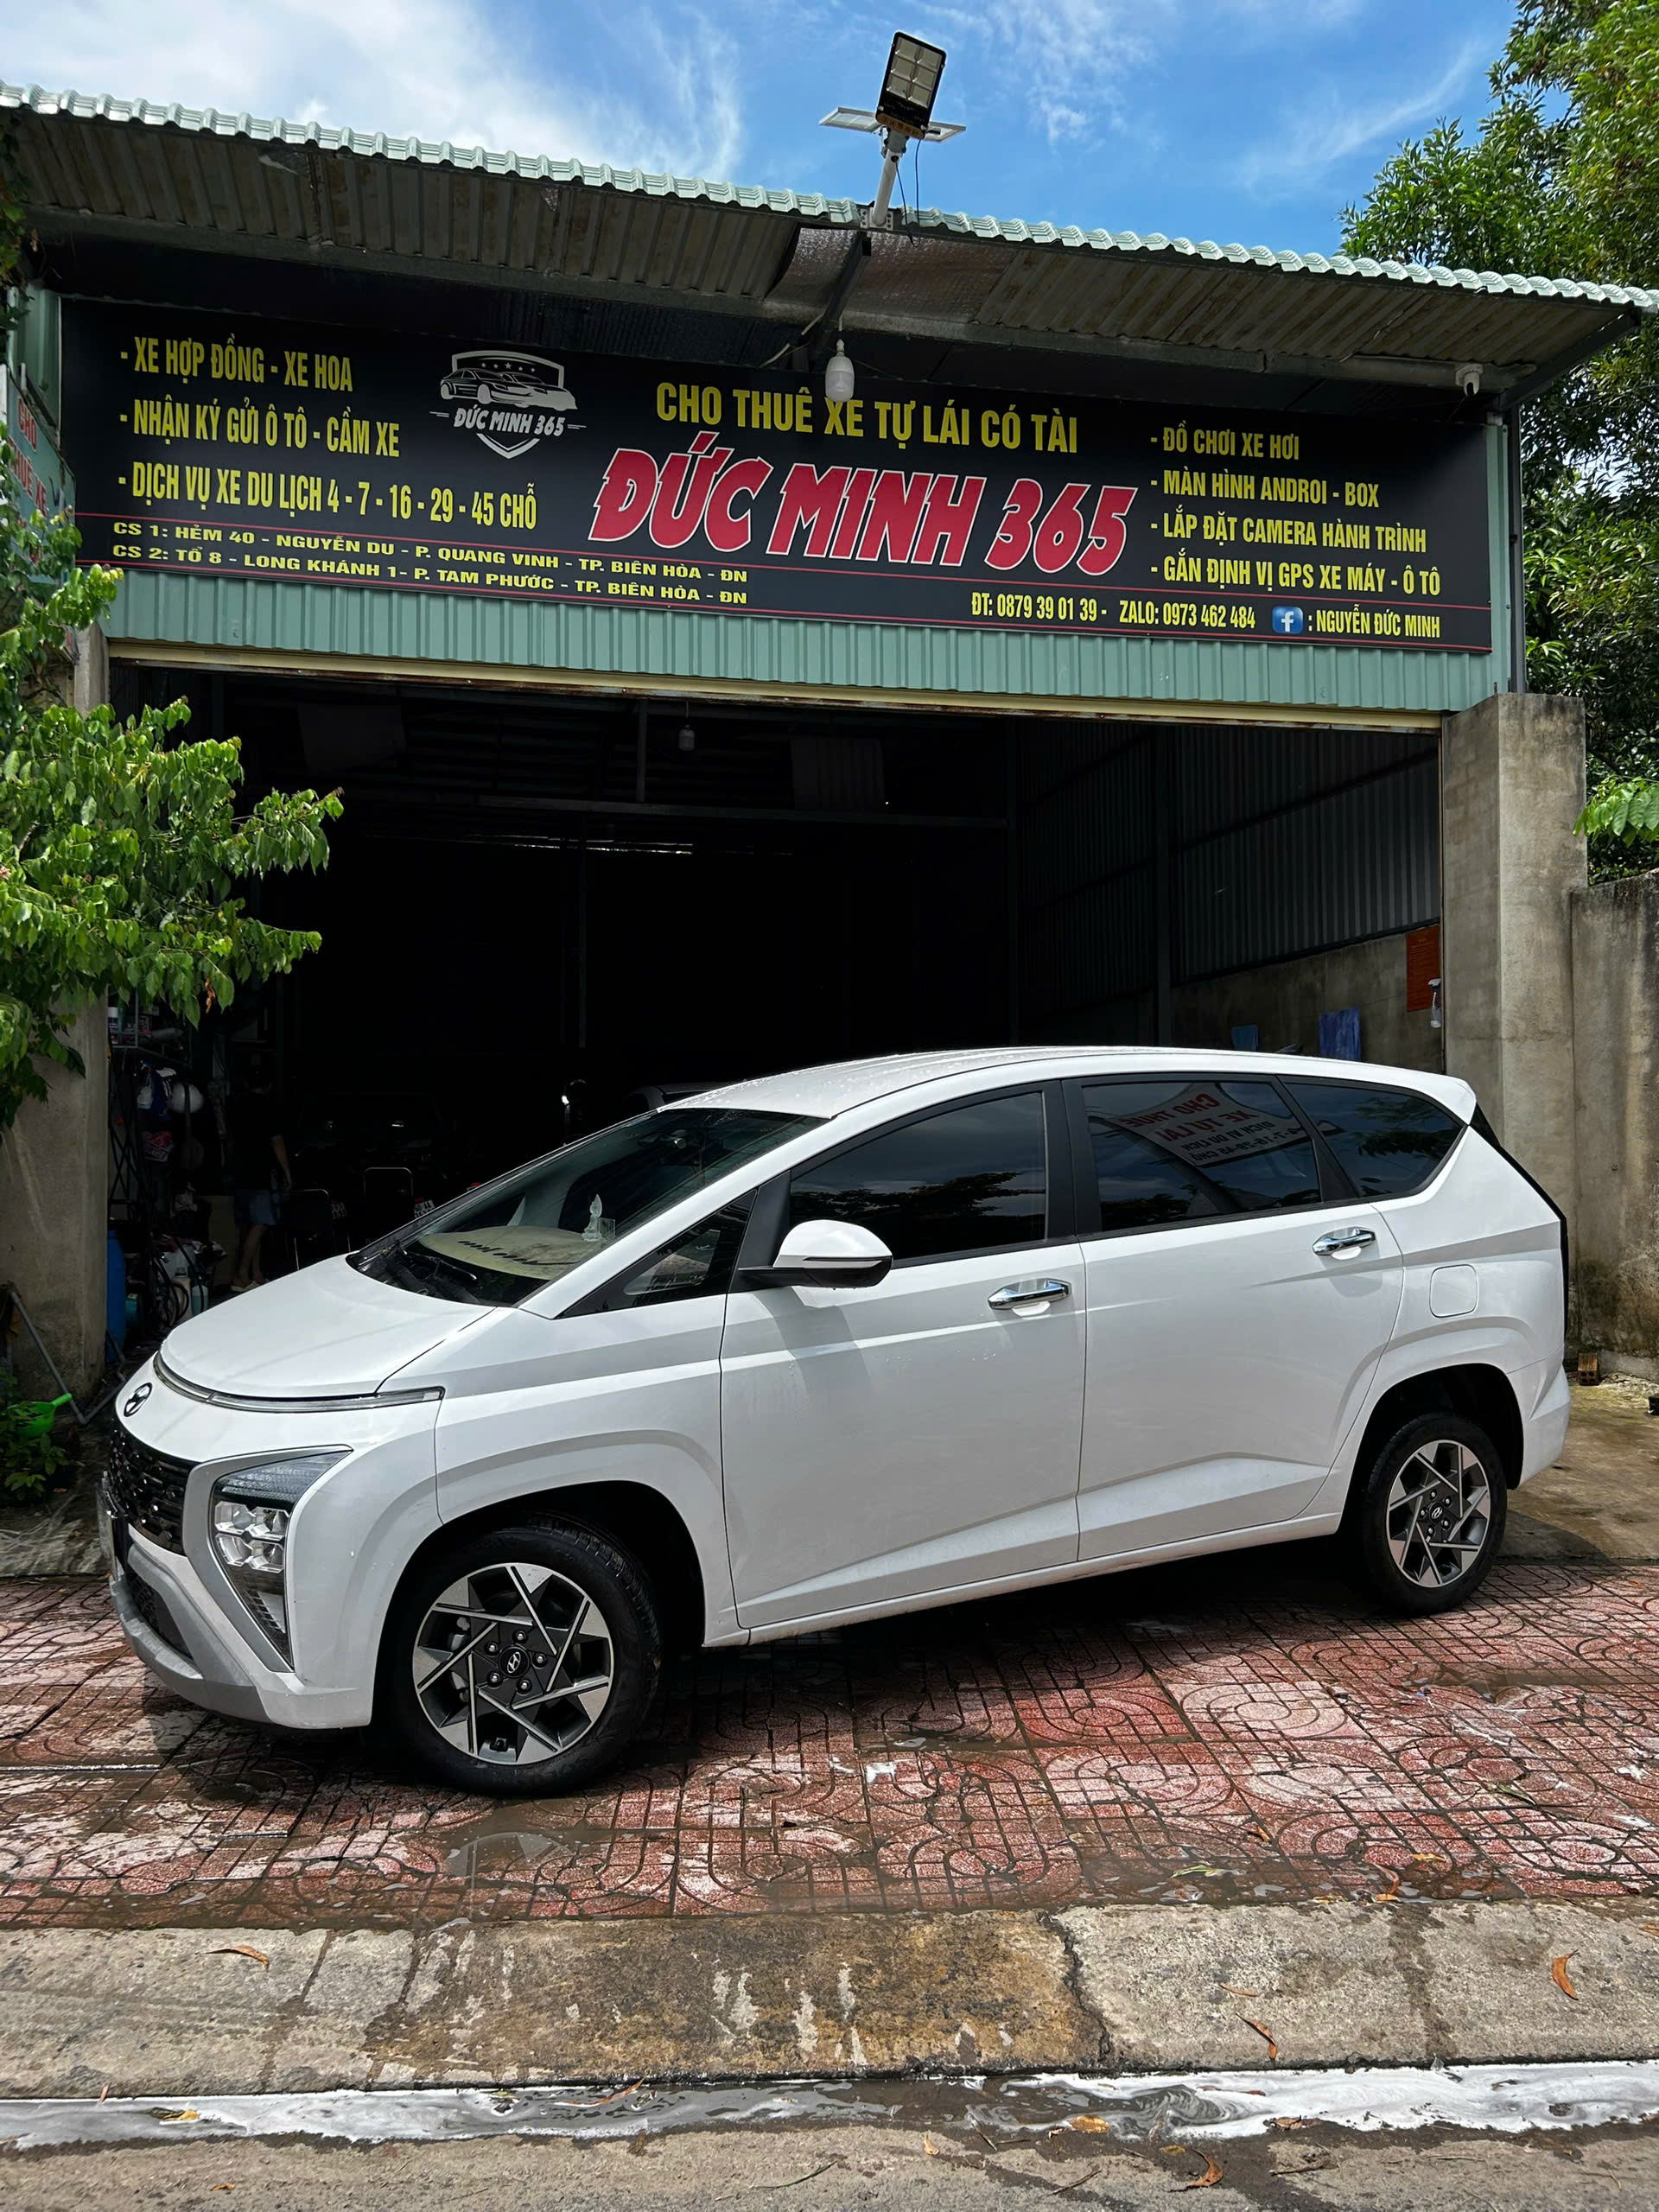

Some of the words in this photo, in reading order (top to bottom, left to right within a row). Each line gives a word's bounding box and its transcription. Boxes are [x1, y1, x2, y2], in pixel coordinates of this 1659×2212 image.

[134, 336, 160, 373] XE
[165, 337, 205, 385] HỢP
[210, 333, 264, 384] ĐỒNG
[283, 351, 308, 388] XE
[315, 353, 353, 392] HOA
[18, 397, 37, 451] CHO
[133, 393, 190, 445] NHẬN
[195, 397, 221, 442] KÝ
[226, 397, 259, 445] GỬI
[265, 404, 278, 447] Ô
[283, 406, 307, 449] TÔ
[327, 406, 370, 455] CẦM
[375, 421, 400, 458] XE
[453, 404, 490, 430] ĐỨC
[488, 410, 534, 434] MINH
[533, 415, 566, 437] 365
[656, 382, 722, 425] CHO
[732, 386, 813, 434] THUÊ
[823, 397, 865, 438] XE
[874, 400, 916, 450] TỰ
[923, 398, 970, 446] LÁI
[981, 404, 1021, 449] CÓ
[1030, 407, 1077, 454] TÀI
[1162, 419, 1188, 453] ĐỒ
[1193, 429, 1236, 456] CHƠI
[1241, 432, 1264, 458] XE
[1269, 433, 1300, 461] HƠI
[132, 461, 180, 506] DỊCH
[185, 466, 211, 511] VỤ
[215, 468, 241, 505] XE
[247, 471, 273, 508] DU
[279, 474, 322, 518] LỊCH
[327, 479, 340, 513] 4
[358, 481, 370, 516] 7
[389, 484, 412, 519] 16
[429, 487, 454, 523] 29
[471, 491, 494, 526] 45
[499, 482, 537, 530] CHỖ
[588, 430, 774, 552] ĐỨC
[766, 461, 987, 567] MINH
[984, 478, 1138, 576] 365
[1163, 465, 1206, 497] MÀN
[1211, 468, 1255, 500] HÌNH
[1260, 476, 1327, 505] ANDROI
[1344, 481, 1380, 508] BOX
[113, 522, 143, 536] CS
[149, 524, 168, 537] 1:
[228, 531, 255, 544] 40
[276, 534, 360, 553] NGUYỄN
[366, 542, 395, 556] DU
[415, 545, 431, 558] P.
[437, 547, 505, 564] QUANG
[512, 553, 559, 569] VINH
[578, 558, 605, 572] TP.
[611, 560, 657, 575] BIÊN
[663, 563, 702, 579] HÒA
[720, 569, 747, 582] ĐN
[1163, 504, 1198, 539] LẮP
[1202, 511, 1238, 547] ĐẶT
[1243, 517, 1318, 546] CAMERA
[1322, 518, 1370, 550] HÀNH
[1375, 522, 1427, 553] TRÌNH
[112, 544, 142, 558] CS
[148, 547, 168, 560] 2:
[175, 546, 203, 563] TỔ
[208, 551, 222, 564] 8
[244, 554, 301, 570] LONG
[307, 559, 380, 576] KHÁNH
[414, 567, 430, 581] P.
[436, 569, 479, 584] TAM
[486, 573, 554, 590] PHƯỚC
[574, 580, 601, 594] TP.
[607, 582, 654, 597] BIÊN
[660, 584, 701, 601] HÒA
[719, 590, 747, 604] ĐN
[1163, 547, 1202, 582] GẮN
[1206, 558, 1251, 589] ĐỊNH
[1255, 561, 1273, 592] VỊ
[1278, 562, 1314, 588] GPS
[1319, 564, 1342, 590] XE
[1347, 562, 1386, 593] MÁY
[1402, 564, 1414, 594] Ô
[1419, 566, 1440, 596] TÔ
[971, 592, 993, 616] ĐT:
[996, 593, 1033, 619] 0879
[1036, 595, 1054, 620] 39
[1058, 596, 1074, 620] 01
[1079, 597, 1097, 622] 39
[1119, 600, 1160, 625] ZALO:
[1162, 601, 1198, 626] 0973
[1200, 604, 1227, 628] 462
[1230, 606, 1255, 629] 484
[1316, 603, 1370, 634] NGUYỄN
[1373, 608, 1402, 637] ĐỨC
[1404, 614, 1440, 639] MINH
